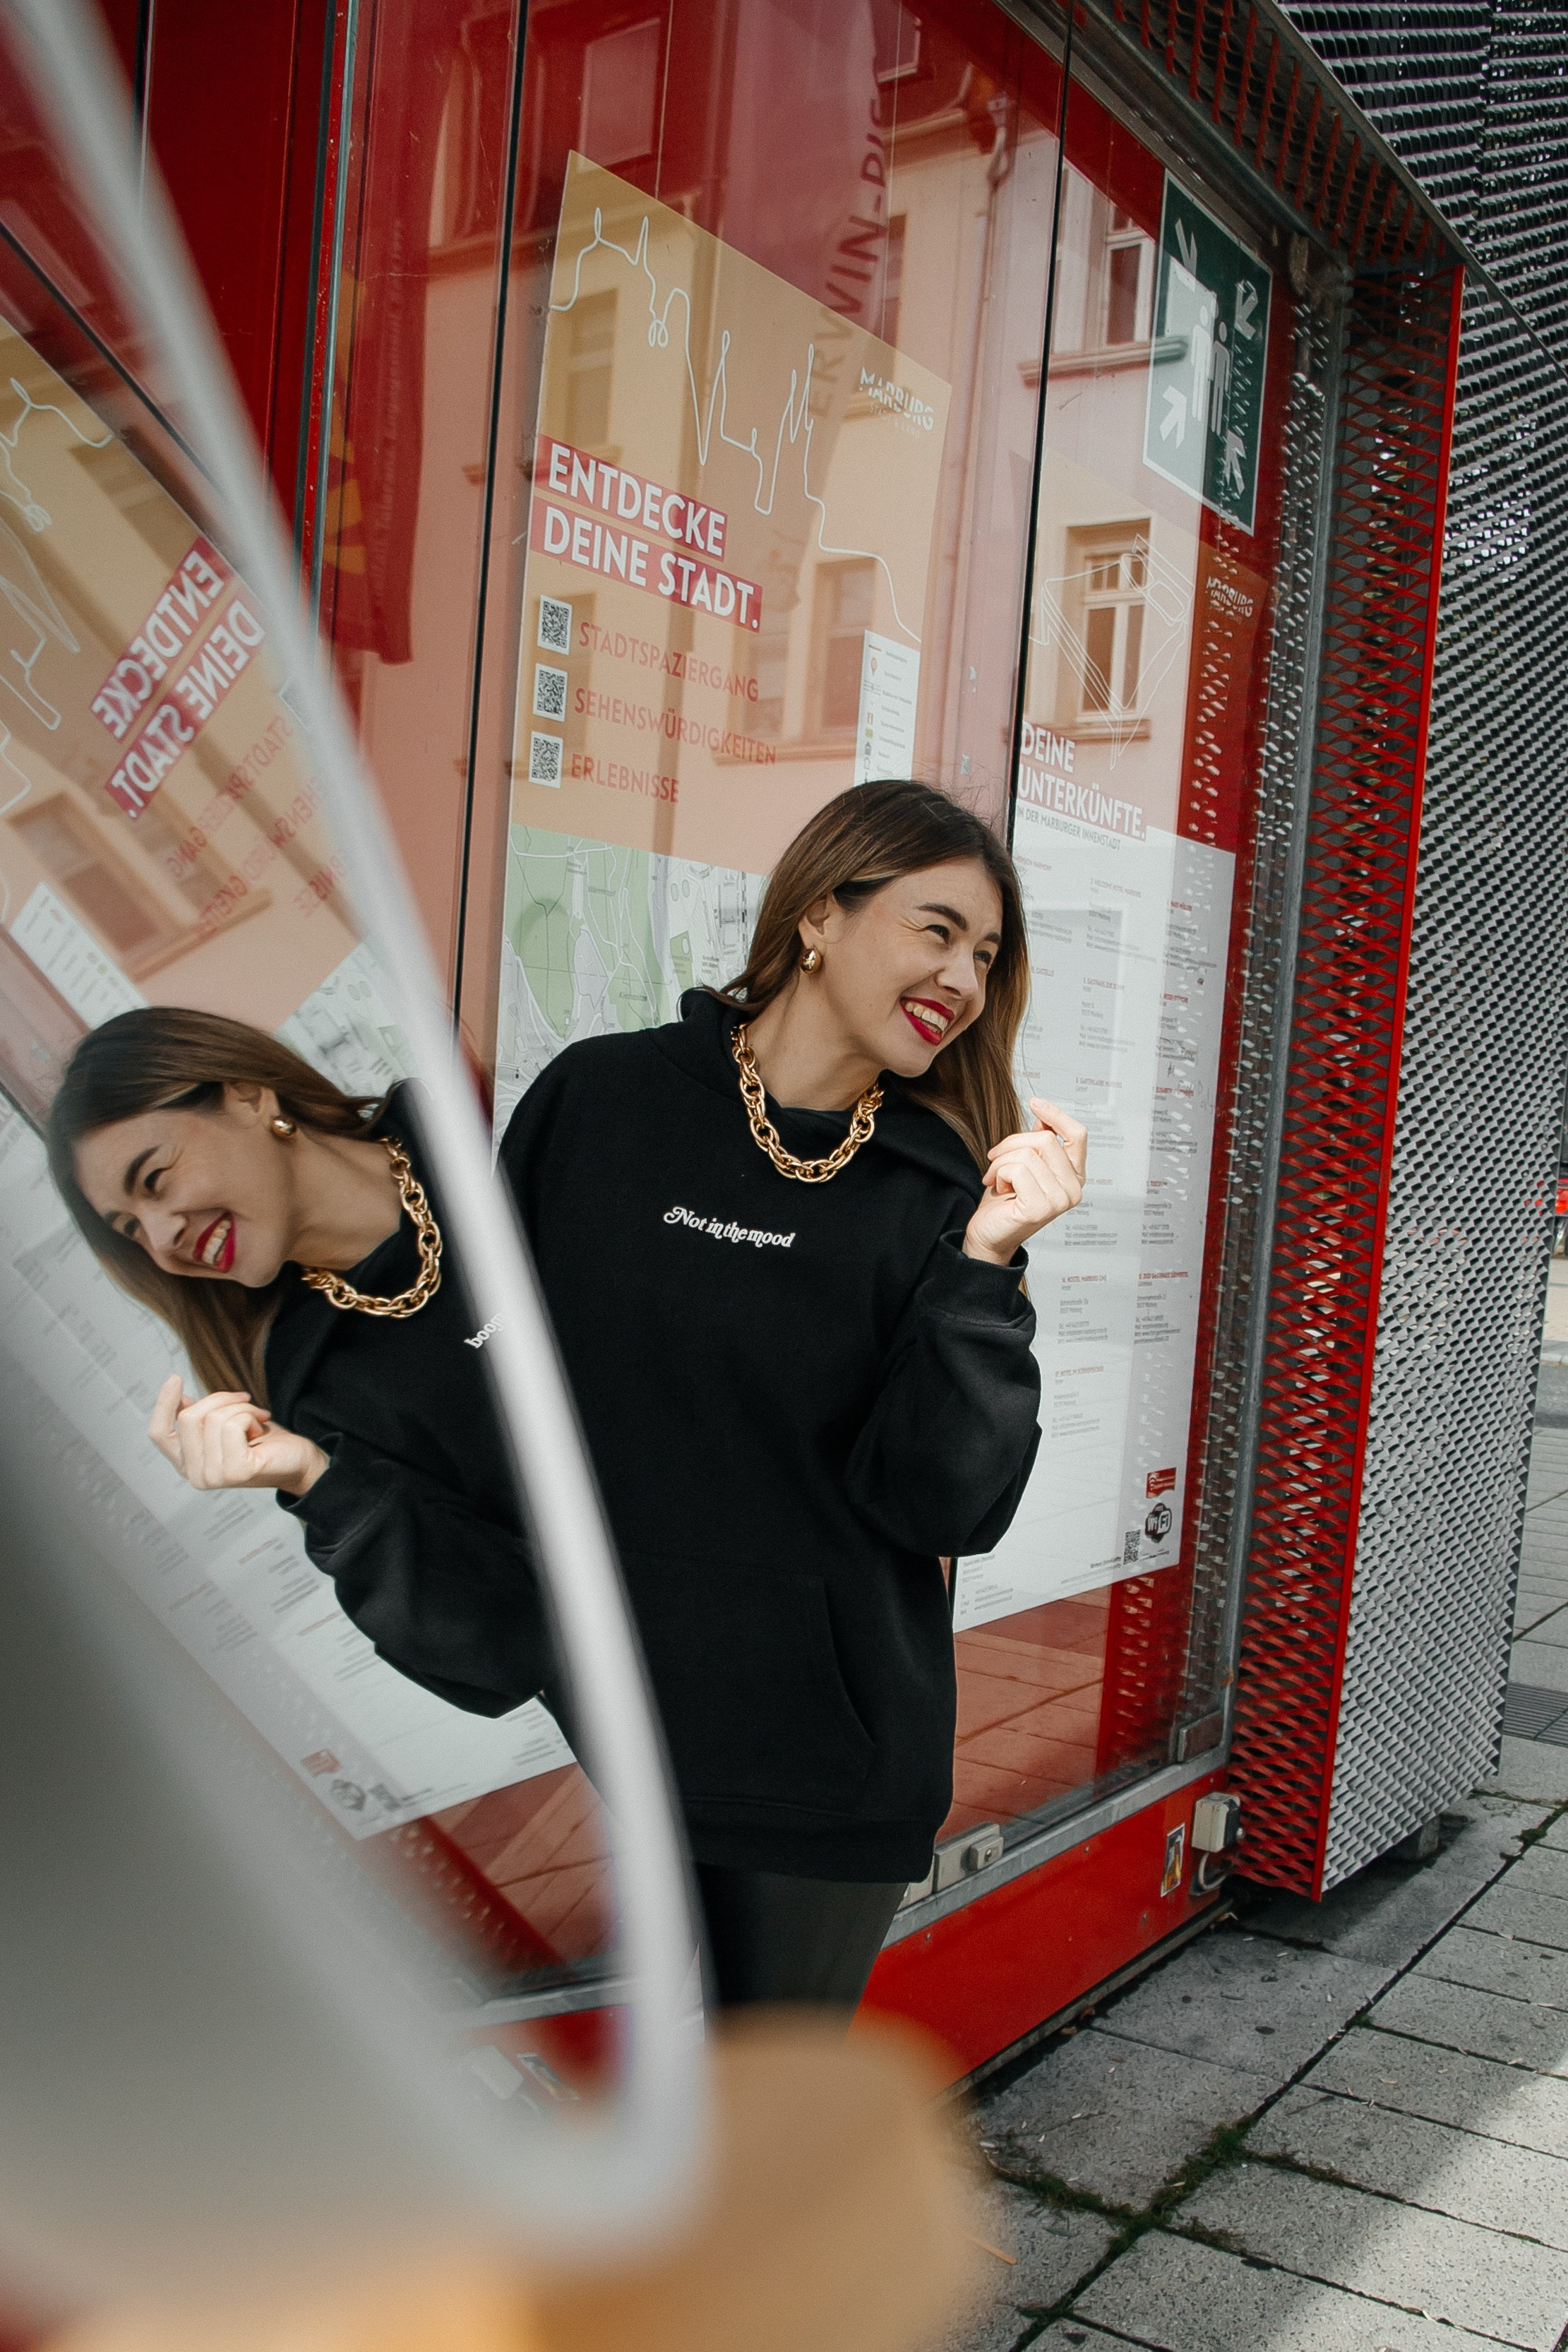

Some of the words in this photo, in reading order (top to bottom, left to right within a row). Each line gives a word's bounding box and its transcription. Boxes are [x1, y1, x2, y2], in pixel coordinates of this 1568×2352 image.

[549, 443, 726, 556] ENTDECKE
[544, 506, 649, 587] DEINE
[658, 552, 759, 629] STADT.
[579, 621, 759, 703] STADTSPAZIERGANG
[575, 688, 776, 765] SEHENSWÜRDIGKEITEN
[1021, 720, 1075, 773] DEINE
[571, 753, 679, 804] ERLEBNISSE
[1017, 763, 1146, 839] UNTERKÜNFTE.
[1026, 808, 1039, 824] DER
[1040, 813, 1081, 838] MARBURGER
[1082, 828, 1121, 851] INNENSTADT
[663, 1206, 707, 1231] Not
